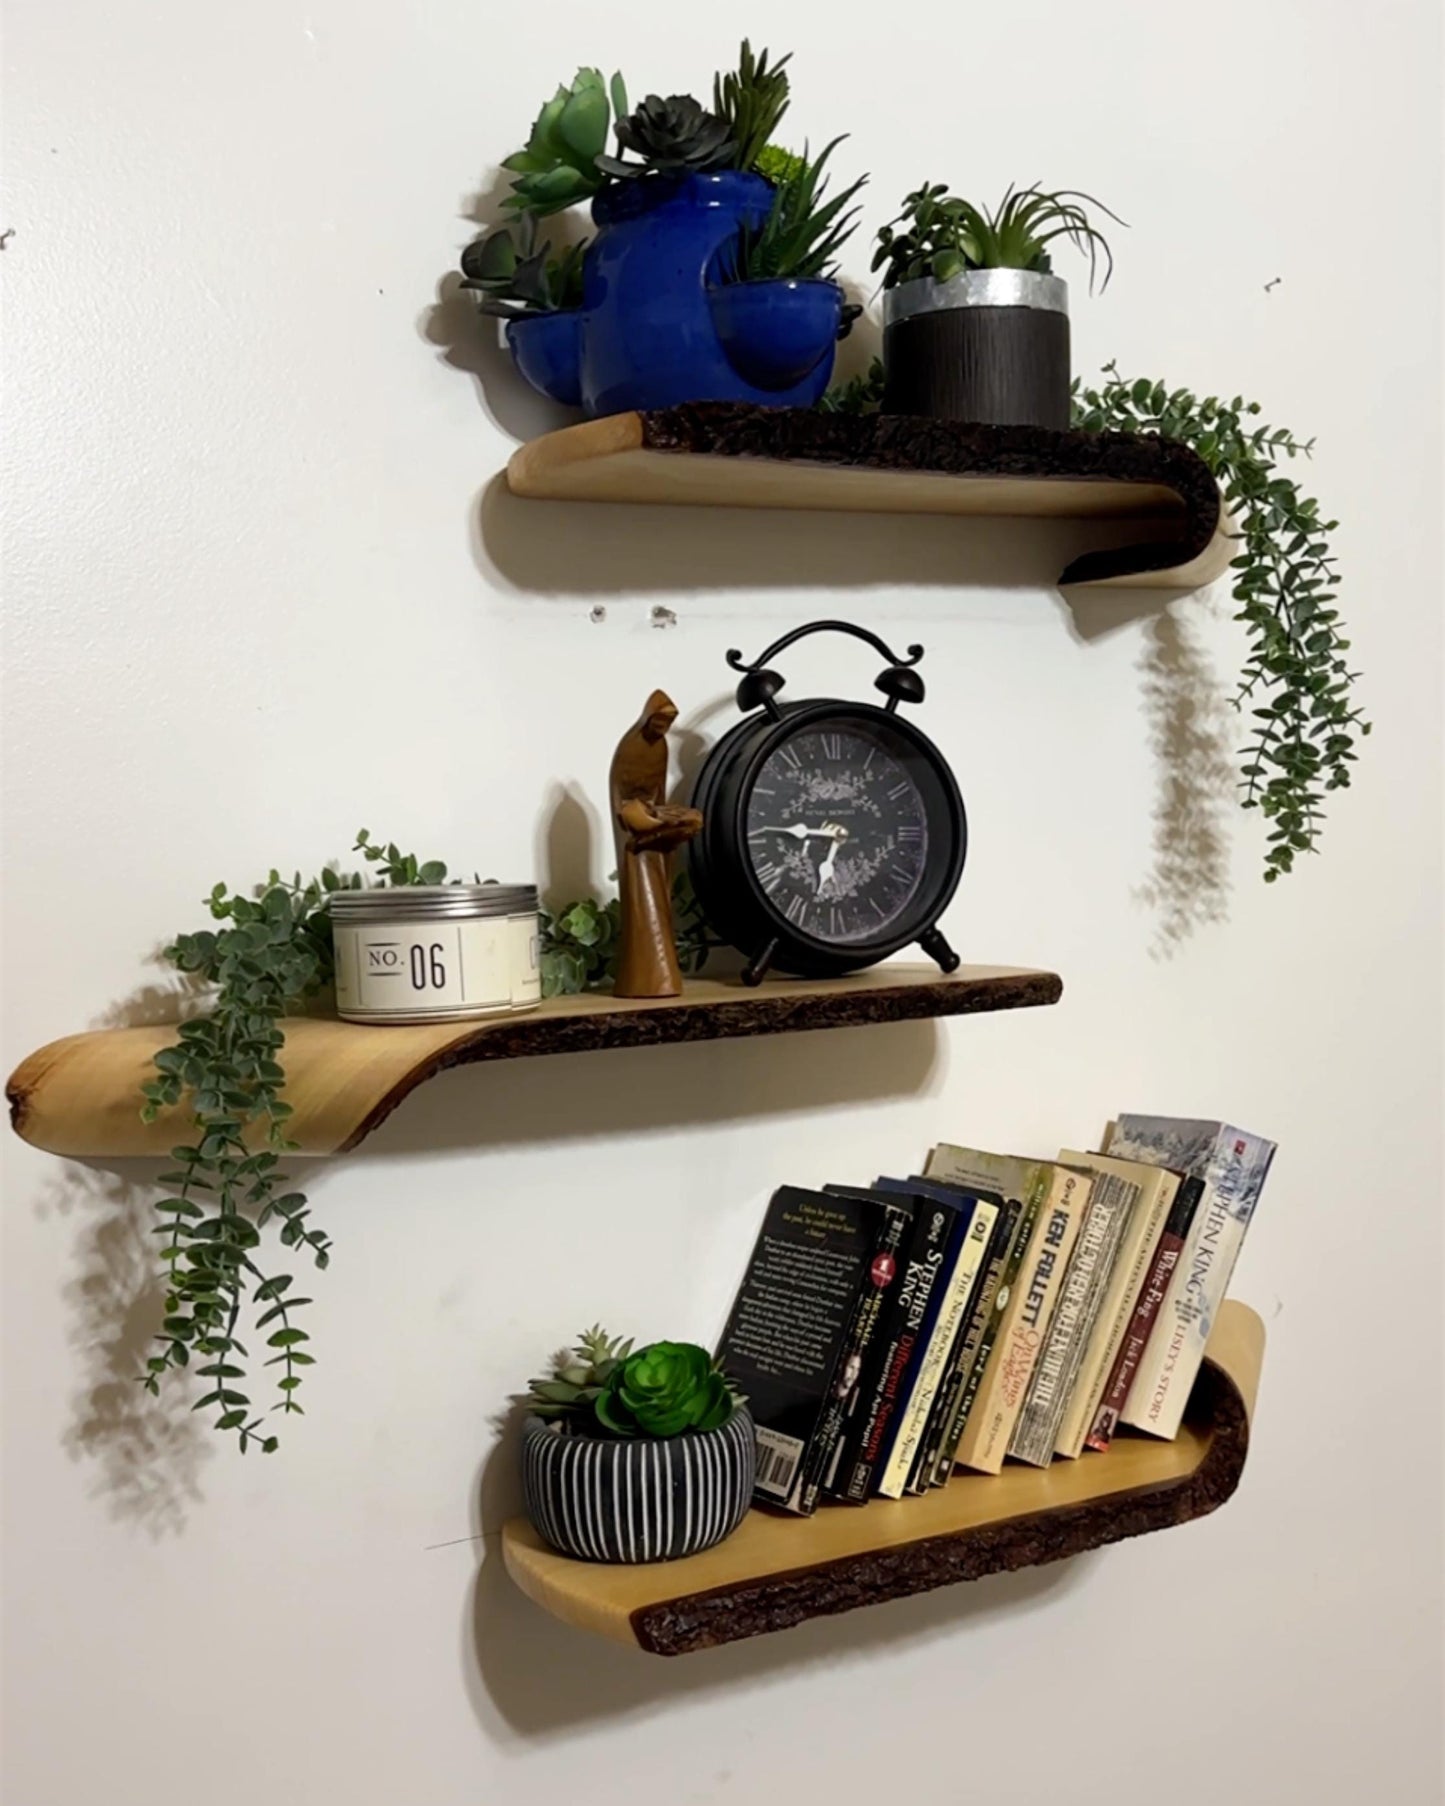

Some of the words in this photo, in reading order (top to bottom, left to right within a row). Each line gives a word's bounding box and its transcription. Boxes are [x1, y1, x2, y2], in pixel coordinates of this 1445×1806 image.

[367, 950, 405, 967] NO.
[410, 943, 446, 990] 06
[1029, 1184, 1045, 1219] william
[1014, 1222, 1032, 1258] golding
[1044, 1209, 1070, 1248] KEN
[898, 1261, 924, 1307] KING
[957, 1272, 971, 1296] THE
[1022, 1249, 1057, 1327] FOLLETT
[1152, 1250, 1178, 1287] White
[1187, 1247, 1214, 1295] KING
[907, 1249, 943, 1330] STEPHEN
[1034, 1375, 1055, 1407] THE
[1056, 1301, 1079, 1333] FOR
[1077, 1203, 1114, 1272] OCTOBER
[1136, 1288, 1162, 1319] Fang
[933, 1300, 962, 1366] NOTEBOOK
[1011, 1326, 1029, 1342] of
[1024, 1330, 1040, 1356] On
[1126, 1336, 1143, 1360] Jack
[1165, 1325, 1186, 1371] LISEY'S
[877, 1342, 898, 1392] featuring
[885, 1335, 915, 1399] Different
[975, 1345, 991, 1372] lord
[1001, 1342, 1025, 1394] Eagles
[970, 1377, 980, 1391] of
[1006, 1356, 1031, 1408] Wings
[1112, 1360, 1133, 1399] London
[1148, 1375, 1170, 1423] STORY
[870, 1394, 882, 1414] Apt
[961, 1395, 972, 1412] the
[861, 1417, 875, 1447] Pupil
[866, 1401, 894, 1461] Seasons
[951, 1414, 967, 1440] flies
